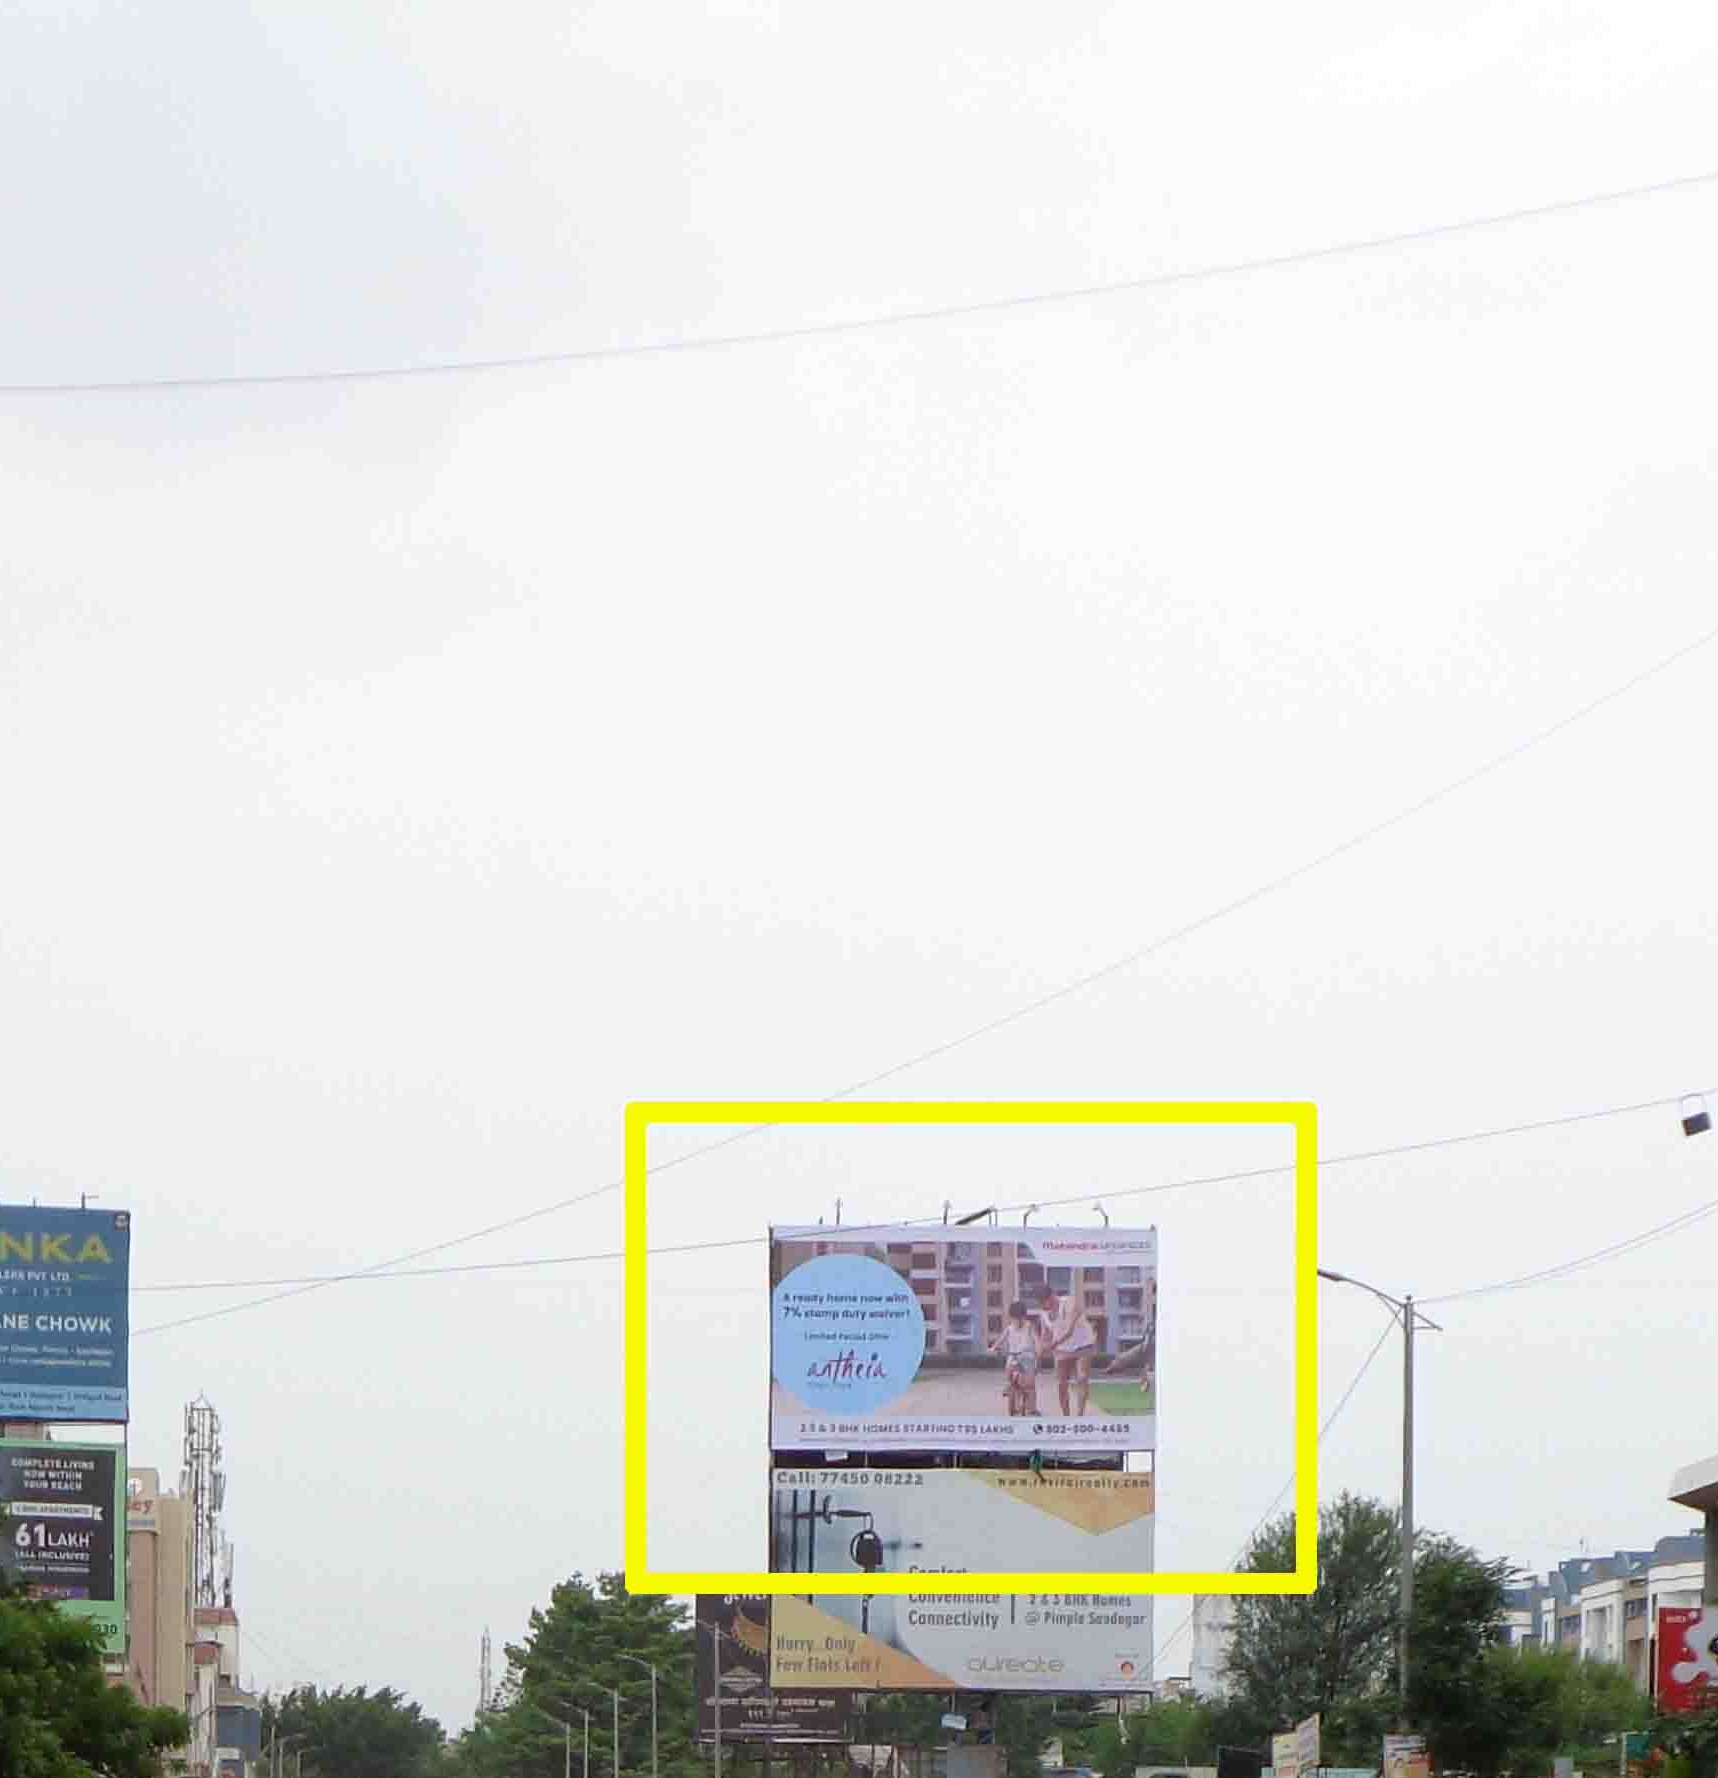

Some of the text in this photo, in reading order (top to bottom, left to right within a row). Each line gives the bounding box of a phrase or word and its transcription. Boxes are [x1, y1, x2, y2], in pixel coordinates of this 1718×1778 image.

[826, 1293, 860, 1302] home
[861, 1294, 883, 1303] now
[783, 1306, 801, 1318] 7%
[804, 1309, 839, 1320] stamp
[842, 1308, 866, 1320] duty
[35, 1314, 113, 1334] CHOWK
[863, 1423, 900, 1433] HOMES
[49, 1471, 82, 1481] WITHIN
[777, 1471, 816, 1485] Call:
[24, 1480, 48, 1489] YOUR
[15, 1523, 47, 1547] 61
[1092, 1594, 1132, 1608] Homes
[909, 1610, 1000, 1629] Connectivity
[1044, 1611, 1084, 1628] Pimple
[1089, 1612, 1146, 1629] Saudagar
